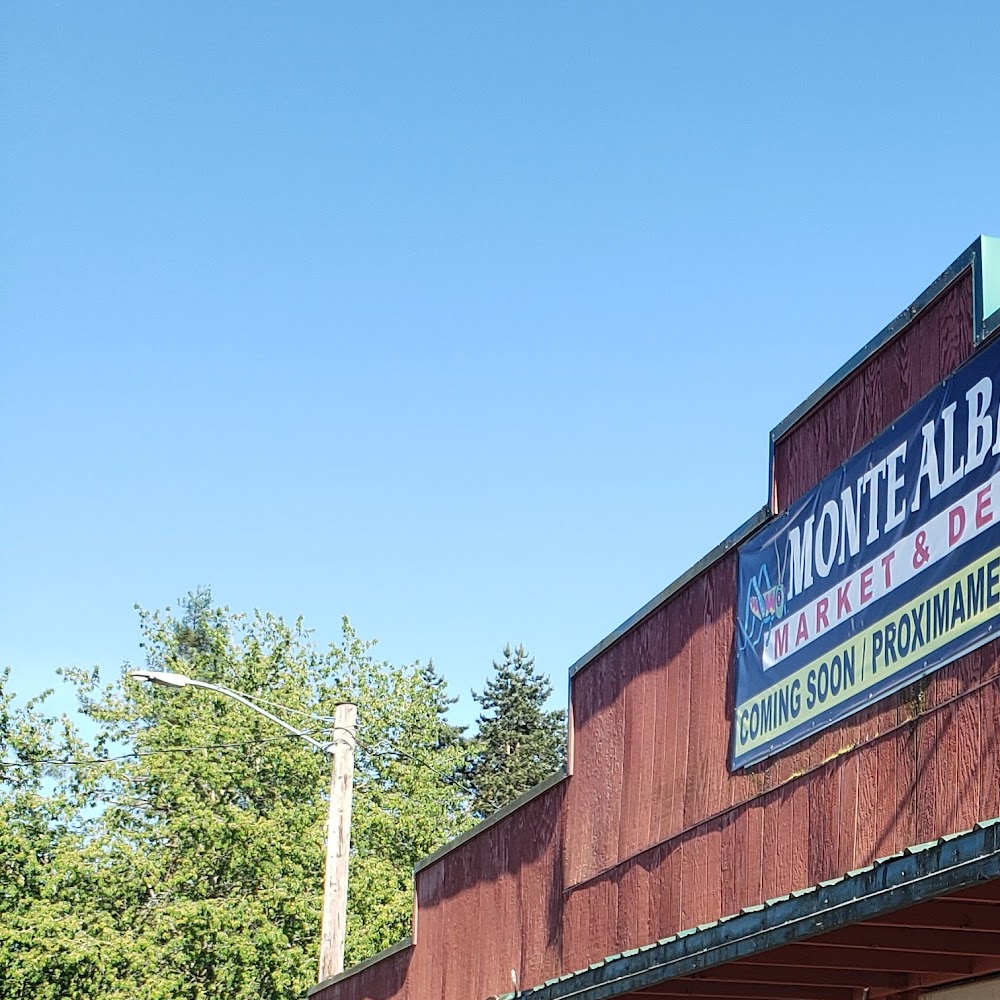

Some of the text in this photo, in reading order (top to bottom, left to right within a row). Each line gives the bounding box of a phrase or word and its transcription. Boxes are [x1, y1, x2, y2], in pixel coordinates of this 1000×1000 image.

[787, 442, 907, 600] MONTE
[773, 551, 896, 660] MARKET
[913, 530, 930, 569] &
[739, 681, 801, 745] COMING
[806, 652, 856, 708] SOON
